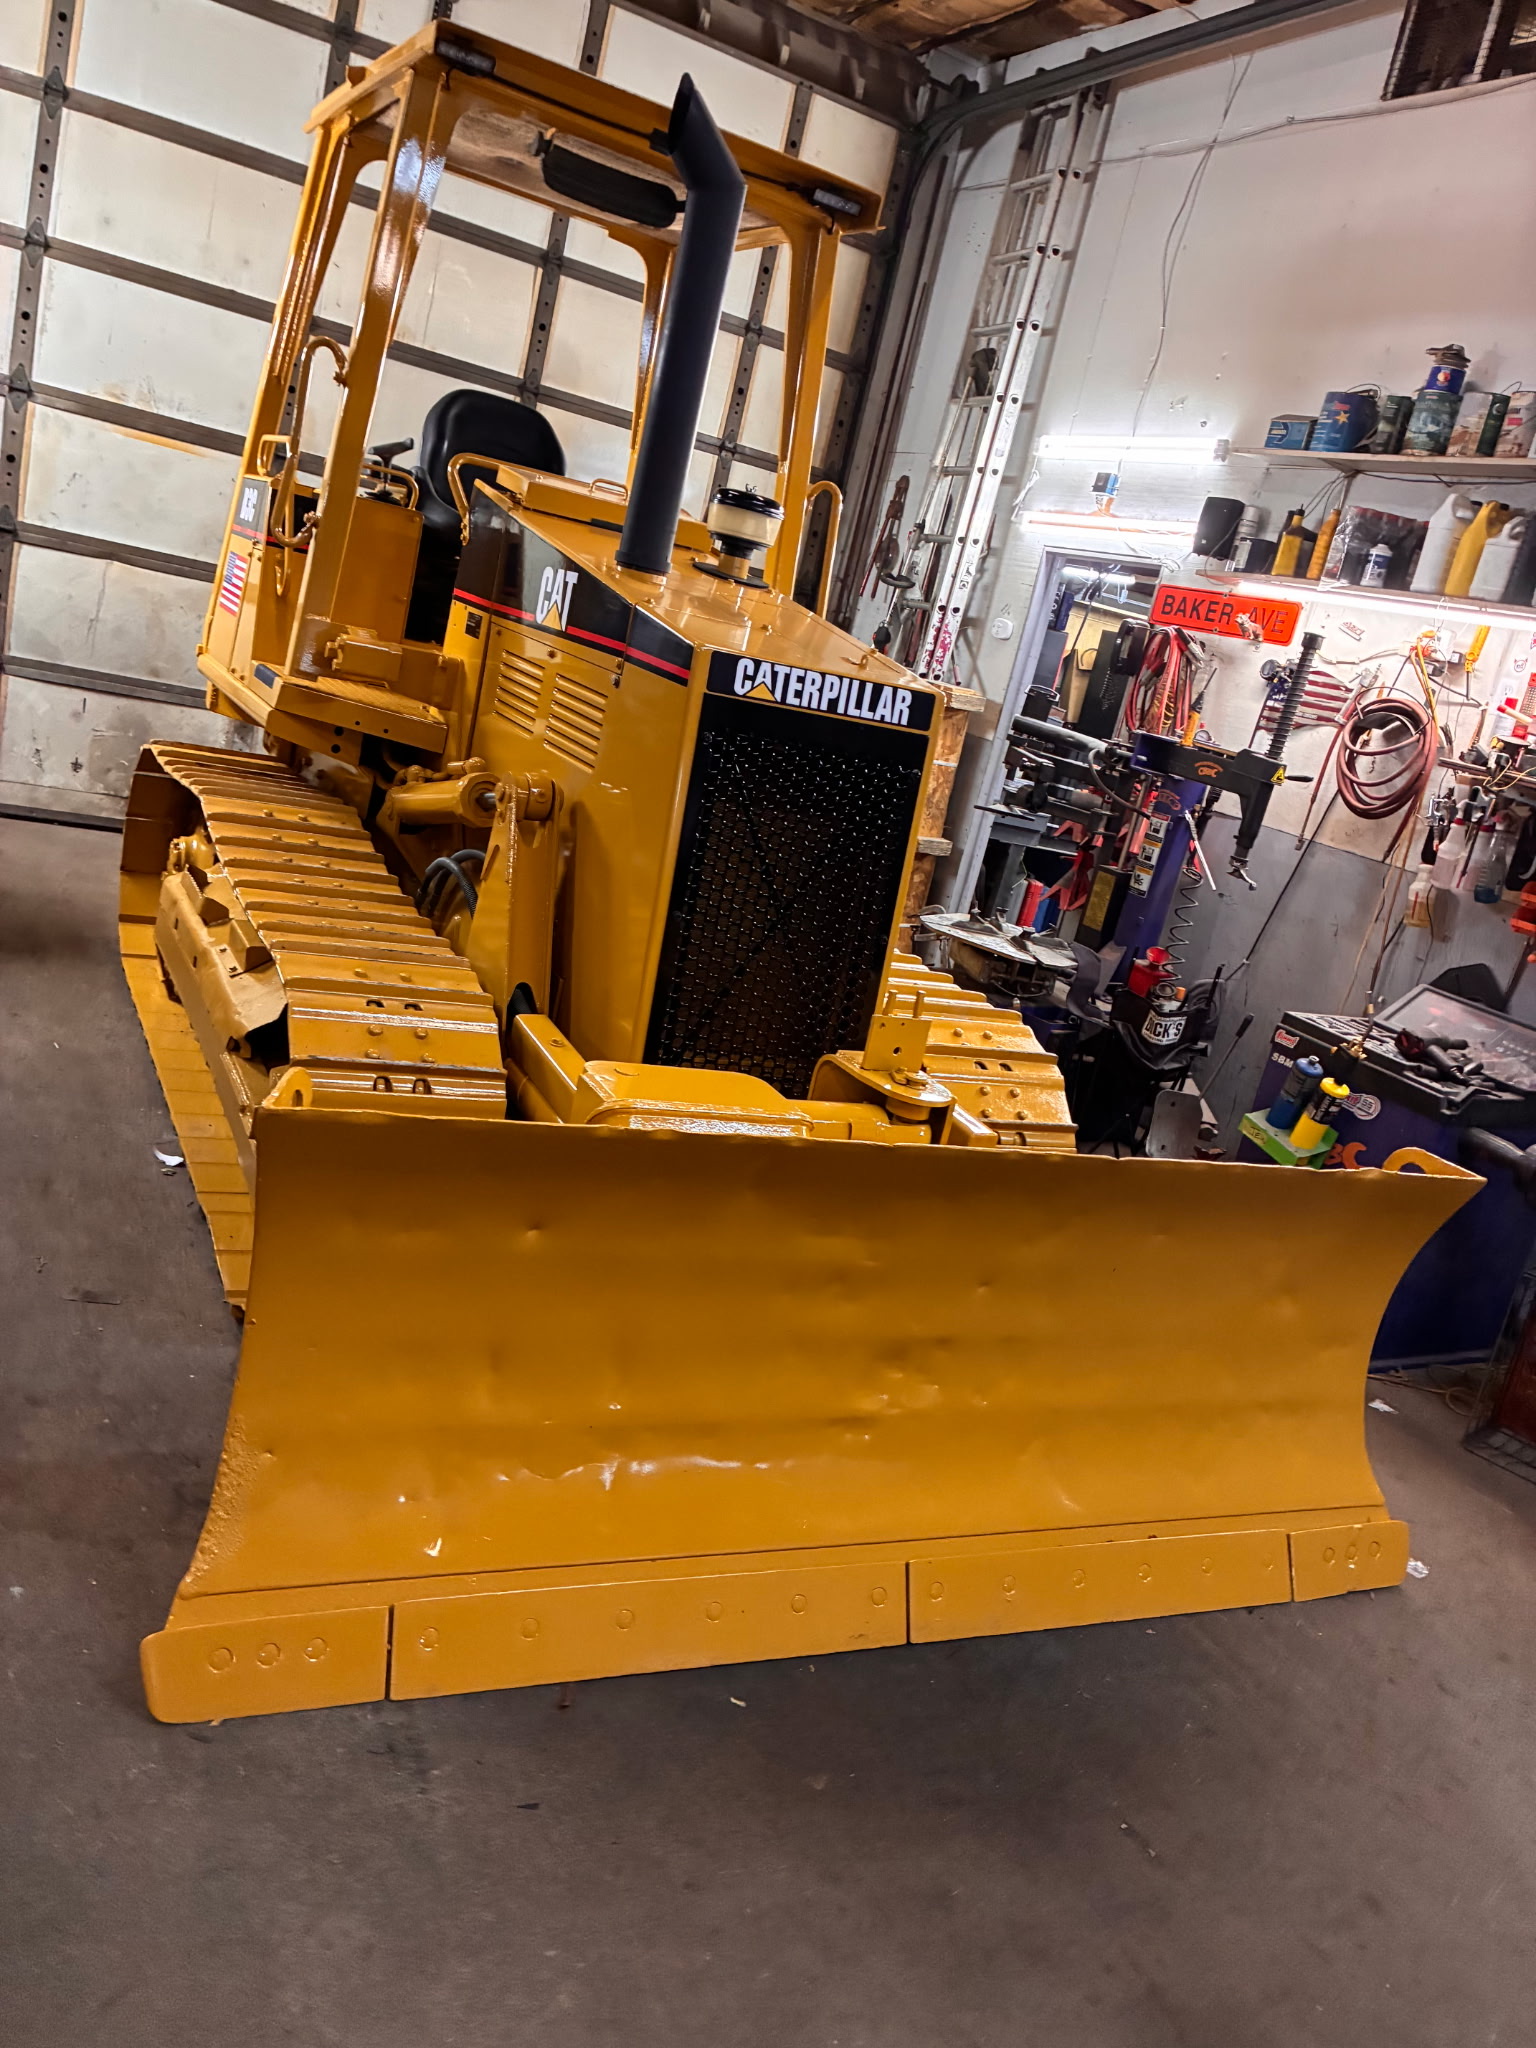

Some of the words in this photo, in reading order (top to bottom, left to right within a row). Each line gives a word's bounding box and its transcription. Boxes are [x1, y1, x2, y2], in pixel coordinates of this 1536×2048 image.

[535, 565, 578, 632] CAT
[1160, 594, 1234, 625] BAKER
[1248, 606, 1289, 634] AVE
[733, 657, 913, 727] CATERPILLAR
[1144, 1016, 1183, 1039] DICK'S
